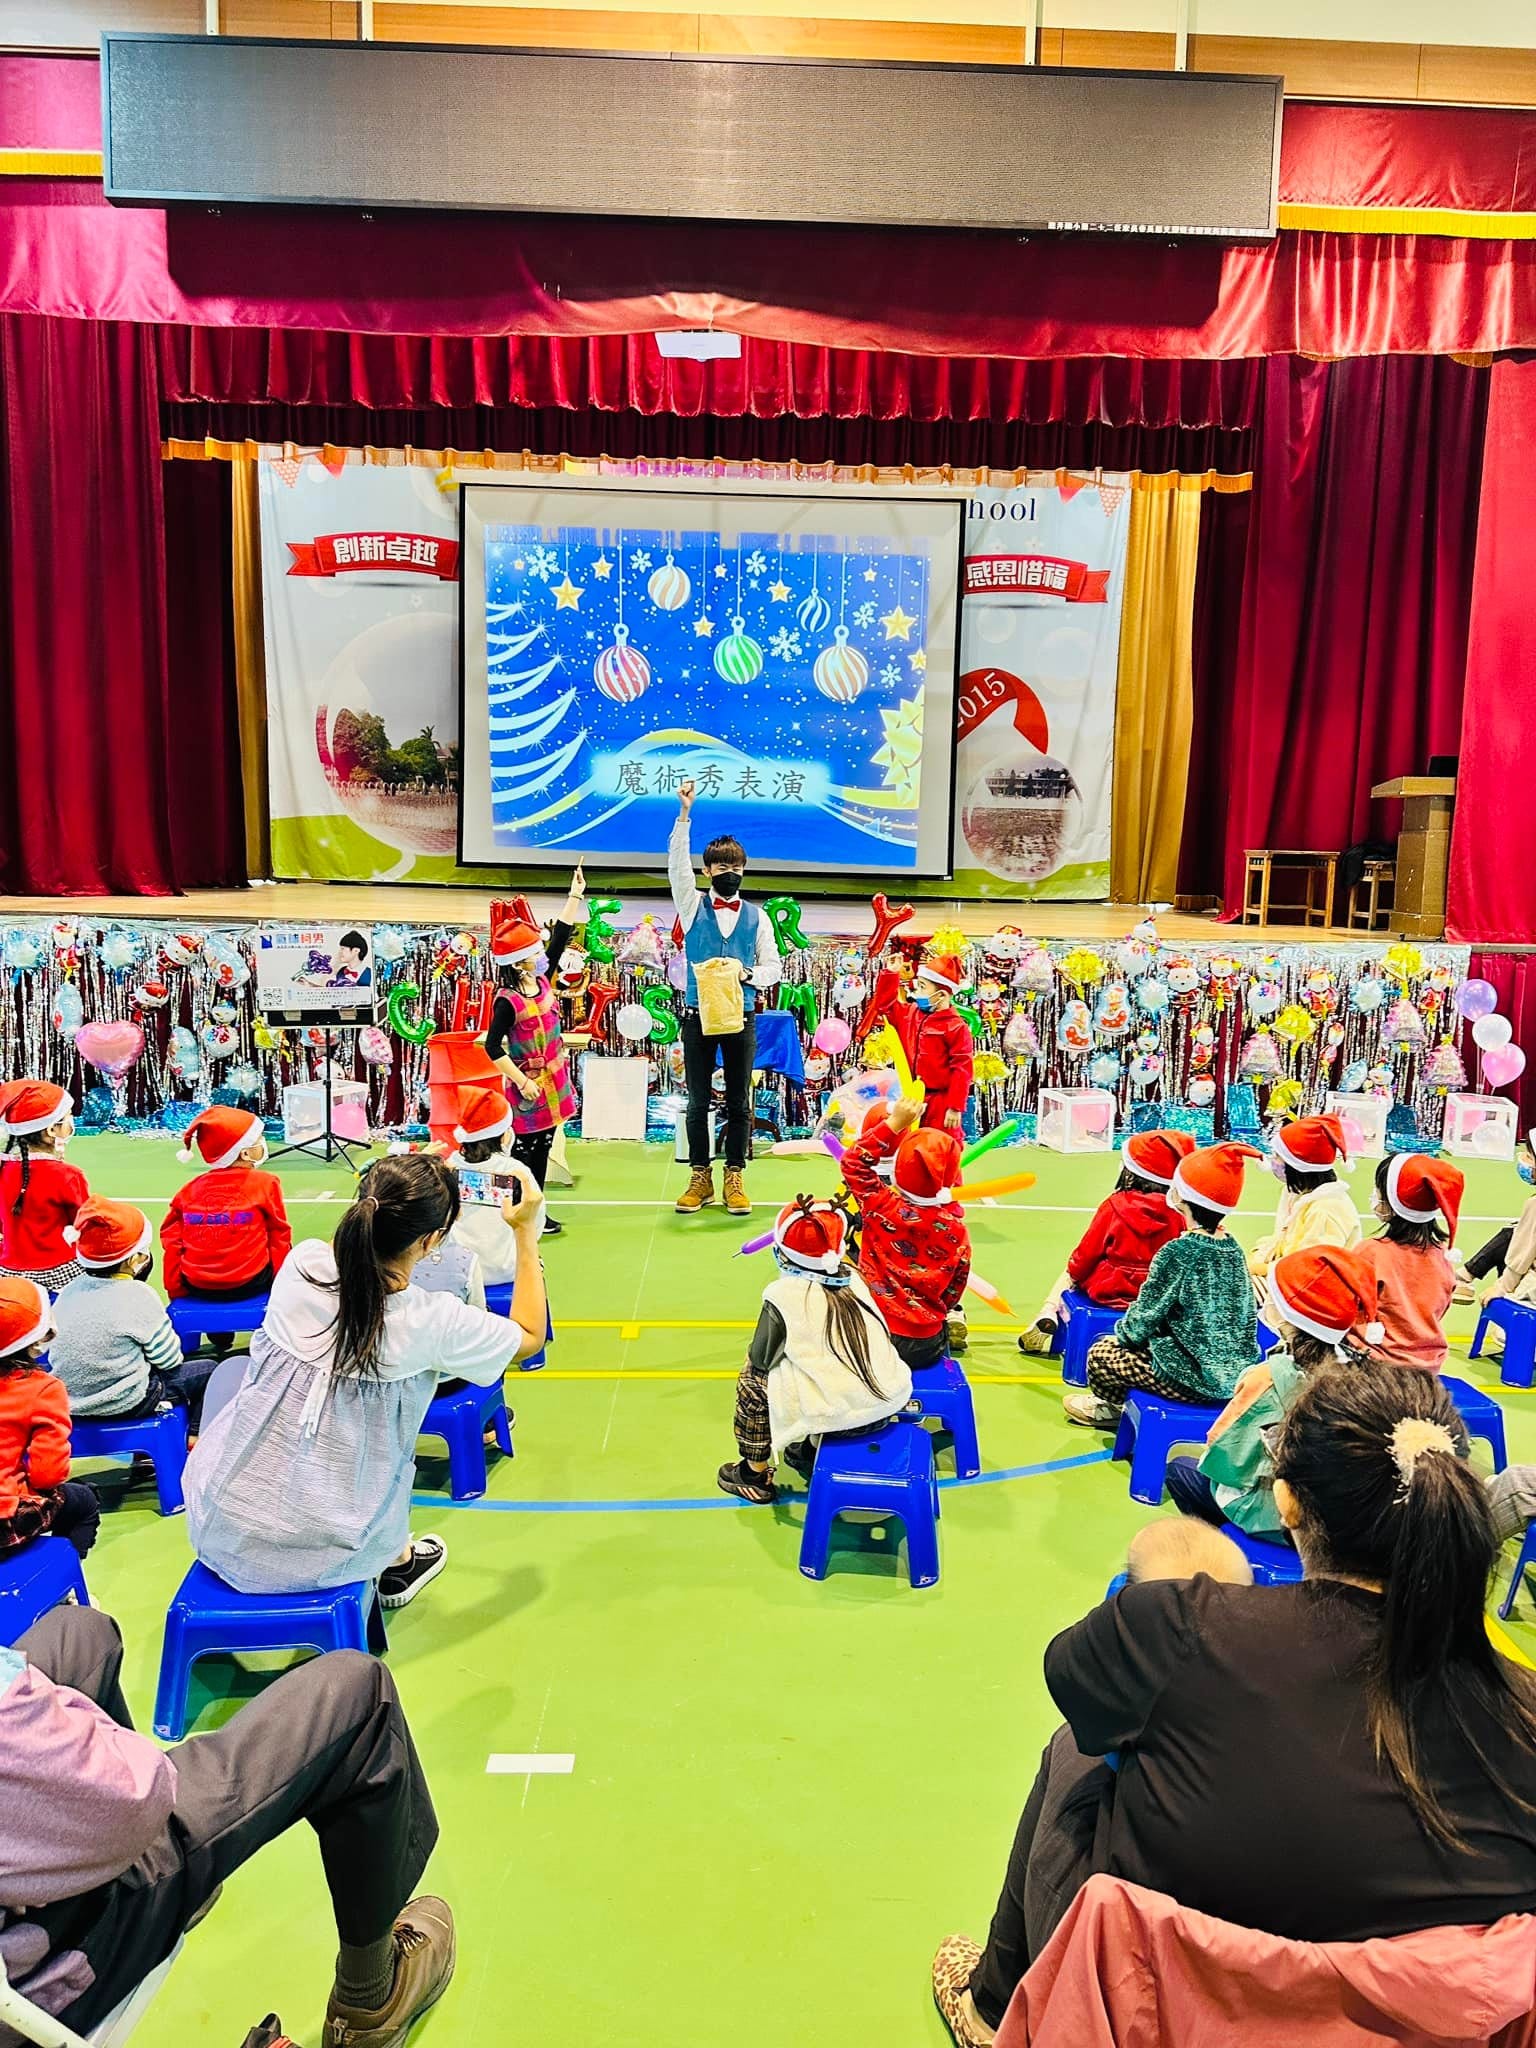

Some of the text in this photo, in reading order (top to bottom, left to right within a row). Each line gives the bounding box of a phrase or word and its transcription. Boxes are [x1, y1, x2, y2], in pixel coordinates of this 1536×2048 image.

[332, 535, 440, 567] 創新卓越
[966, 559, 1070, 590] 感恩惜福
[614, 760, 806, 802] 魔術秀表演
